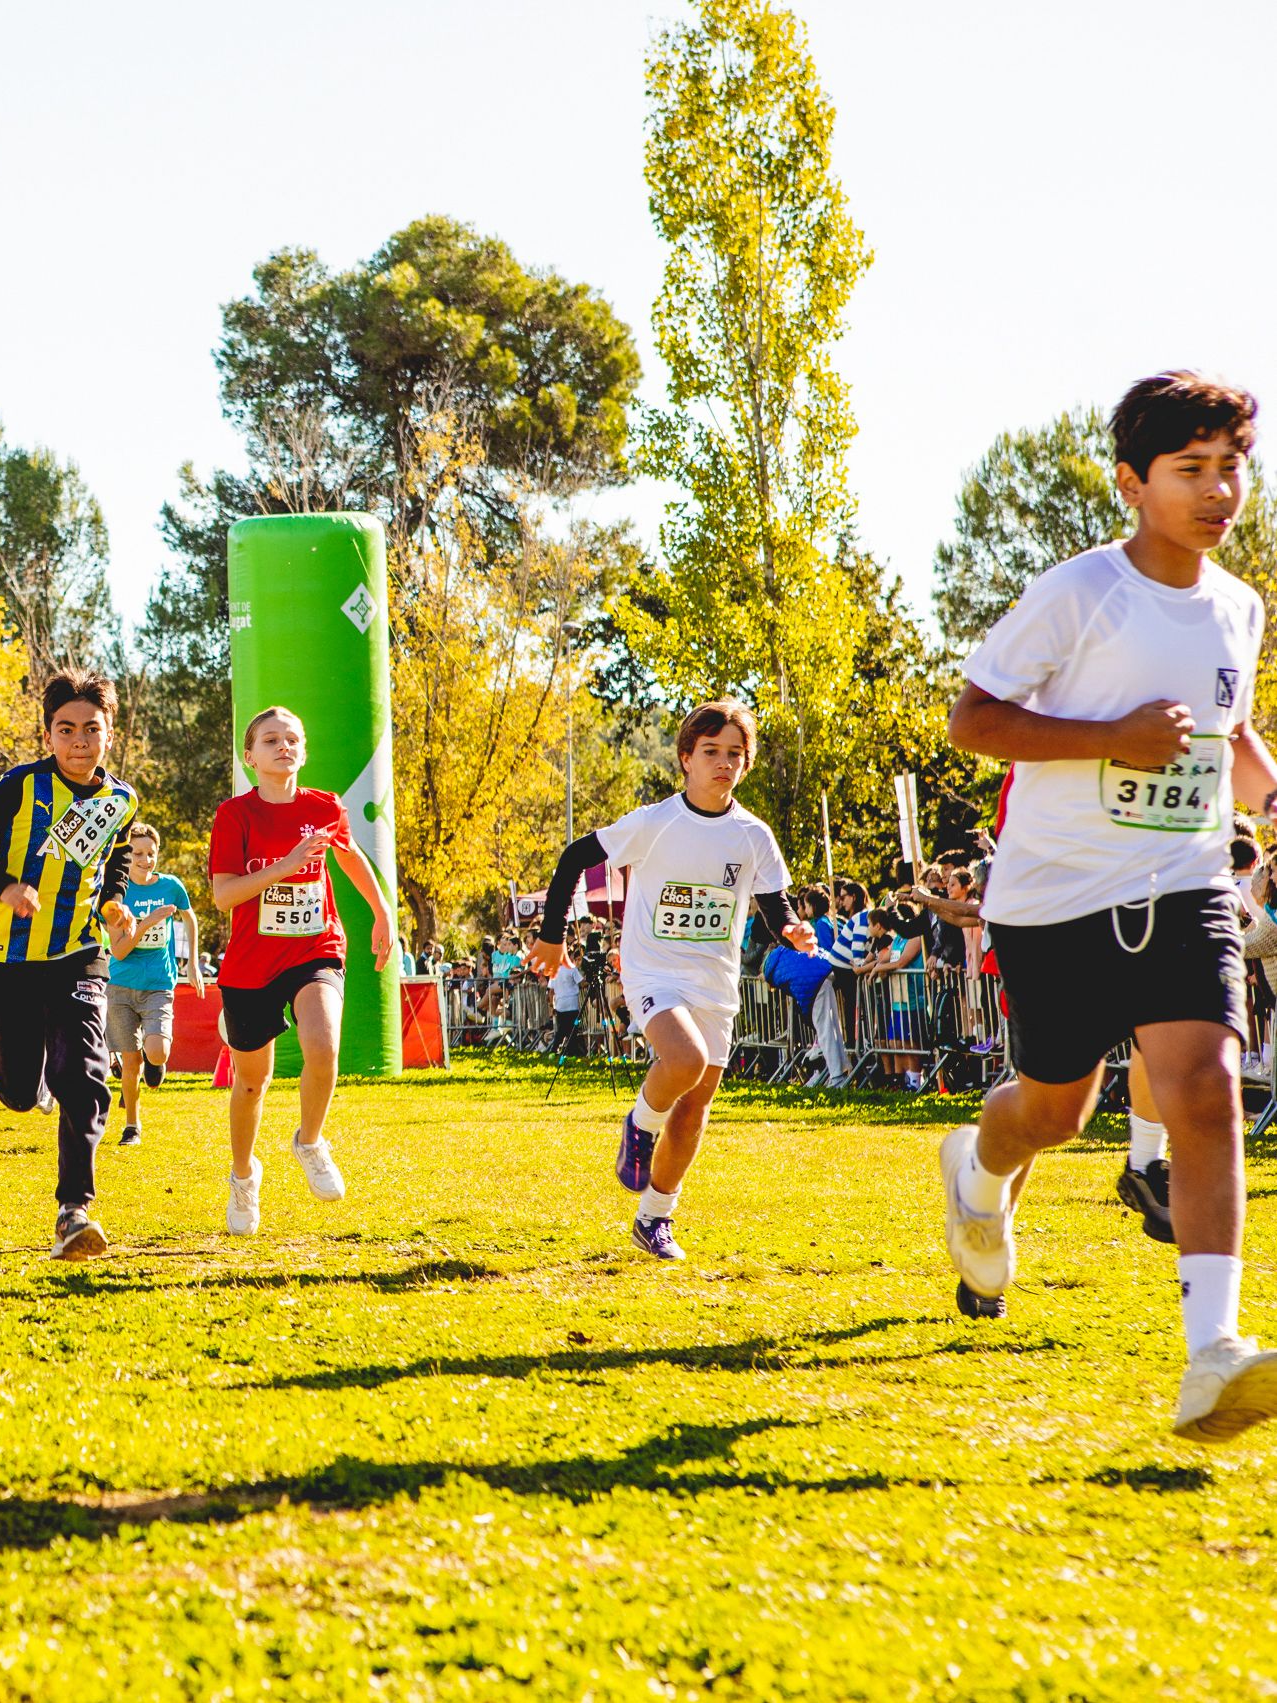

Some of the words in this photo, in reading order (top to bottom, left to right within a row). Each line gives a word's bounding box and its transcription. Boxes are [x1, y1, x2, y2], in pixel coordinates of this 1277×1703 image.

[1117, 779, 1201, 810] 3184
[60, 814, 82, 840] CROS
[75, 802, 116, 853] 2658
[265, 893, 293, 903] CROS
[662, 894, 691, 904] CROS
[275, 911, 312, 924] 550
[663, 912, 721, 928] 3200
[140, 934, 159, 942] 73
